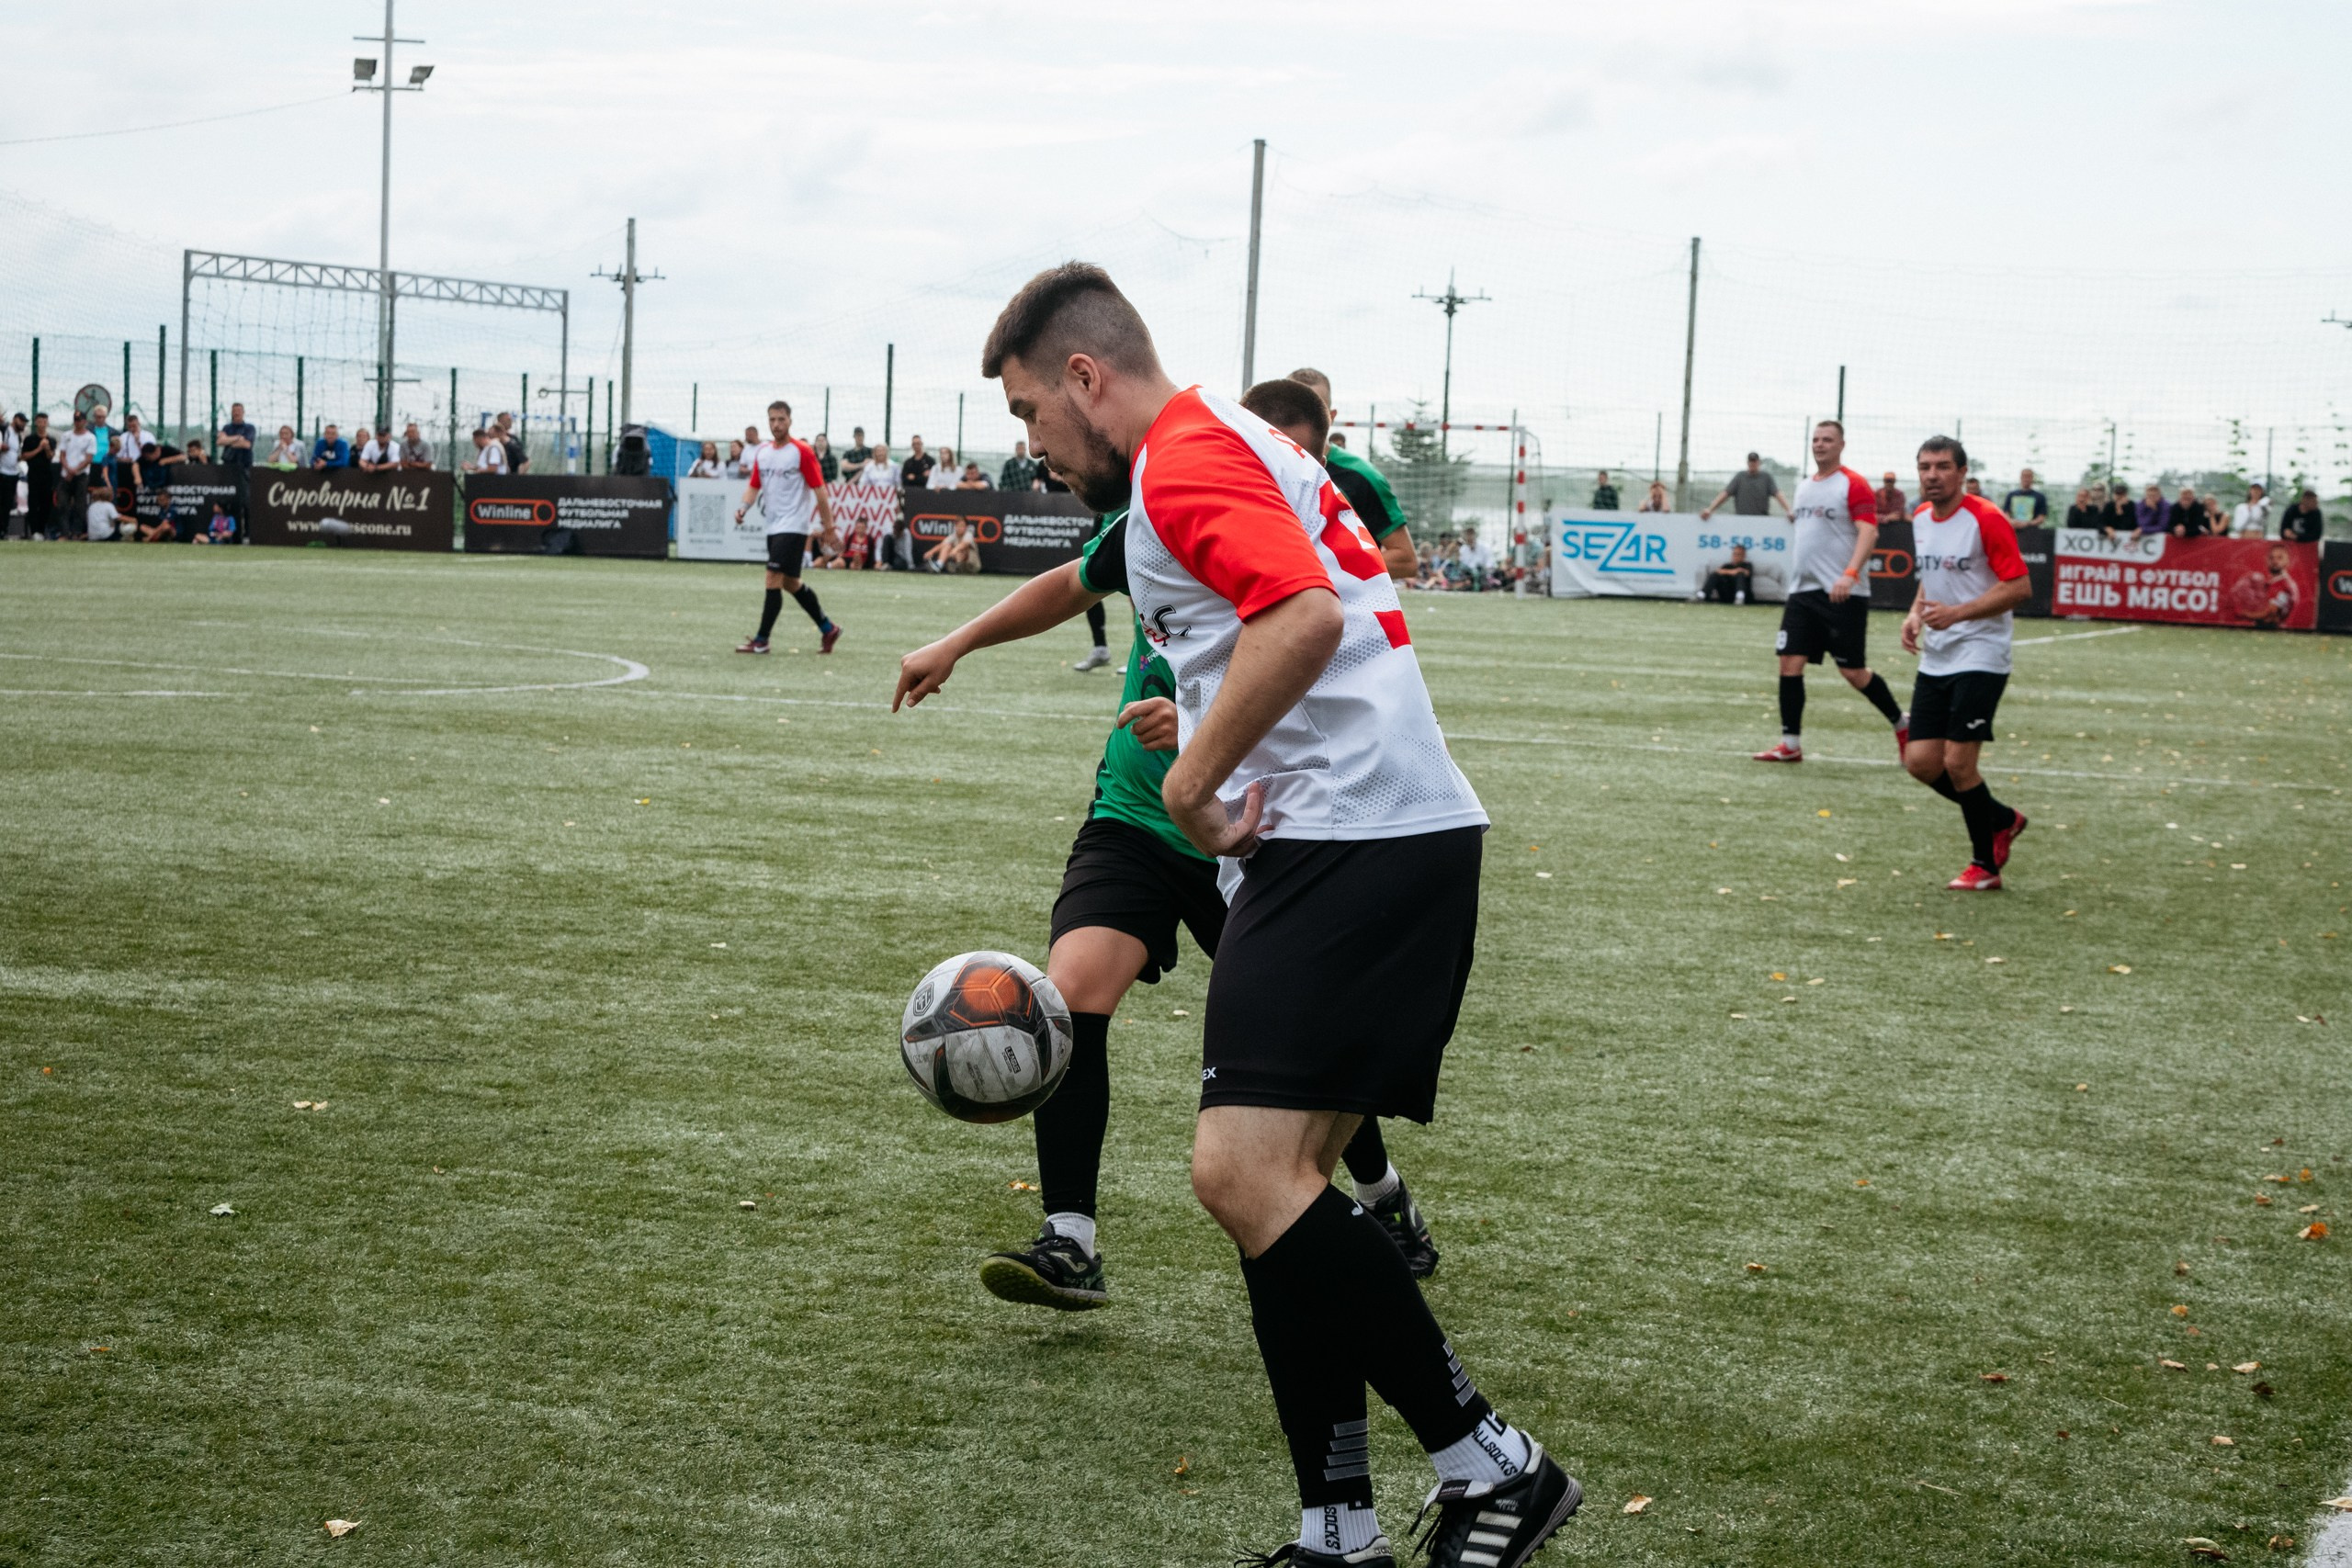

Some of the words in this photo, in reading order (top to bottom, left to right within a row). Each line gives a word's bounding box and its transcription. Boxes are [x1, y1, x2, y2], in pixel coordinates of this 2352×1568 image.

[267, 480, 381, 516] Сироварня
[386, 485, 431, 512] №1
[558, 497, 662, 509] ДАЛЬНЕВОСТОЧНАЯ
[477, 504, 532, 520] Winline
[558, 508, 629, 519] ФУТБОЛЬНАЯ
[558, 519, 622, 529] МЕДИАЛИГА
[1003, 514, 1094, 527] ДАЛЬНЕВОСТОЧ
[1003, 526, 1080, 537] ФУТБОЛЬНАЯ
[1003, 536, 1072, 548] МЕДИАЛИГА
[1698, 534, 1786, 551] 58-58-58
[2059, 562, 2121, 583] ИГРАЙ
[2124, 567, 2137, 583] В
[2140, 568, 2221, 588] ФУТБОЛ
[2057, 582, 2122, 608] ЕШЬ
[2127, 585, 2220, 614] МЯСО!
